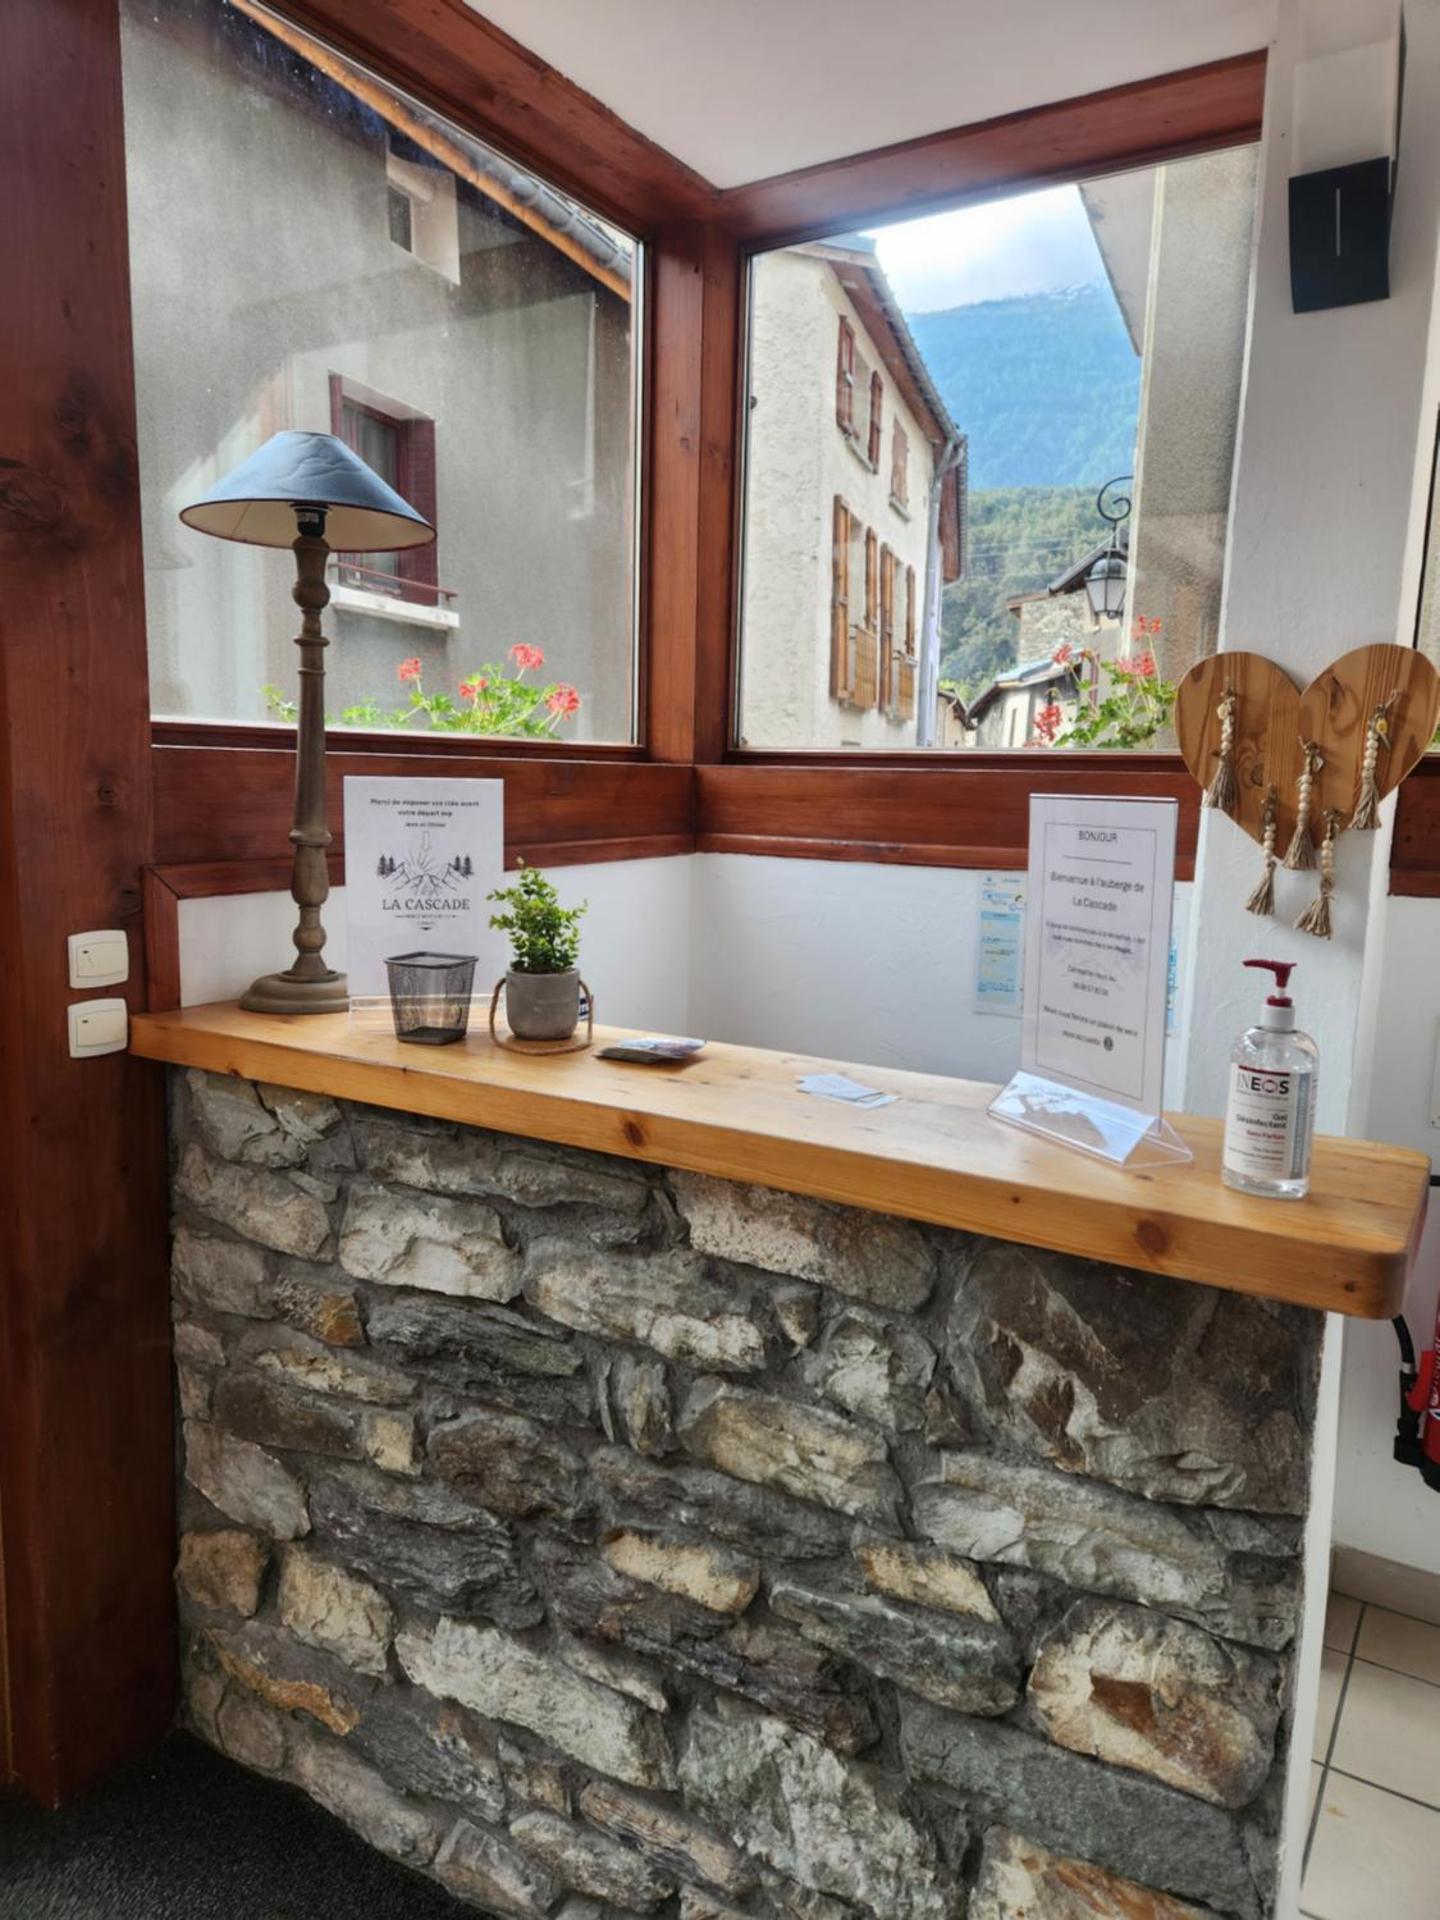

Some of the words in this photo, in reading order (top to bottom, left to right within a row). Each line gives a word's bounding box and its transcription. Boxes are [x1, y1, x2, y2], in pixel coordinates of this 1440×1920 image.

[1078, 830, 1118, 842] BONJOUR
[1050, 871, 1089, 886] Bienvenue
[382, 898, 401, 911] LA
[404, 898, 470, 911] CASCADE
[1072, 896, 1082, 907] La
[1083, 897, 1118, 912] Cascade
